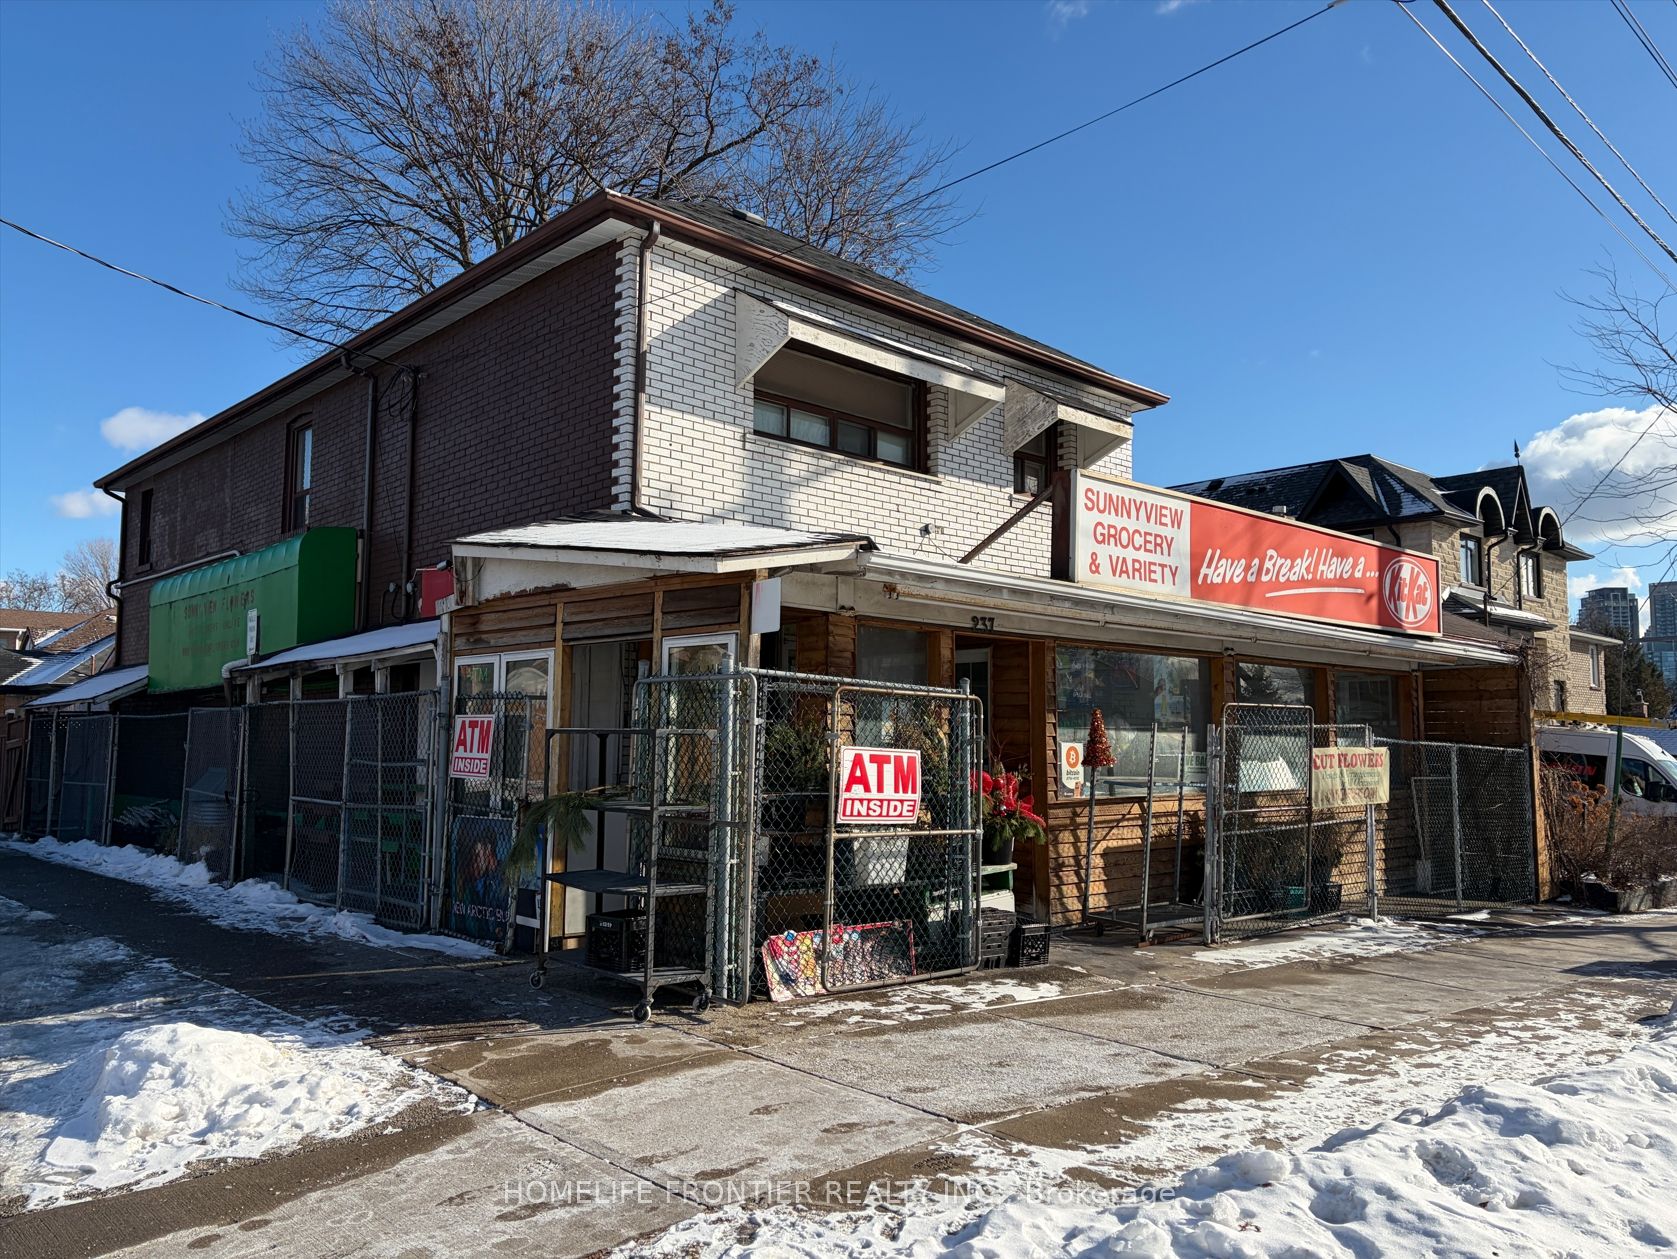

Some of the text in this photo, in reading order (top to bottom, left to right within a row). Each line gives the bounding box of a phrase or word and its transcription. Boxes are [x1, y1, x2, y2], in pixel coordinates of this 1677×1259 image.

[1084, 488, 1183, 530] SUNNYVIEW
[1093, 522, 1174, 557] GROCERY
[1089, 552, 1179, 586] & VARIETY
[1198, 549, 1245, 585] Have
[1247, 560, 1258, 582] a
[1261, 548, 1318, 583] Break!
[1317, 549, 1352, 577] Have
[971, 615, 995, 632] 237
[455, 720, 492, 754] ATM
[453, 758, 487, 775] INSIDE
[844, 752, 918, 795] ATM
[1313, 752, 1383, 770] CUT FLOWERS
[845, 800, 914, 818] INSIDE
